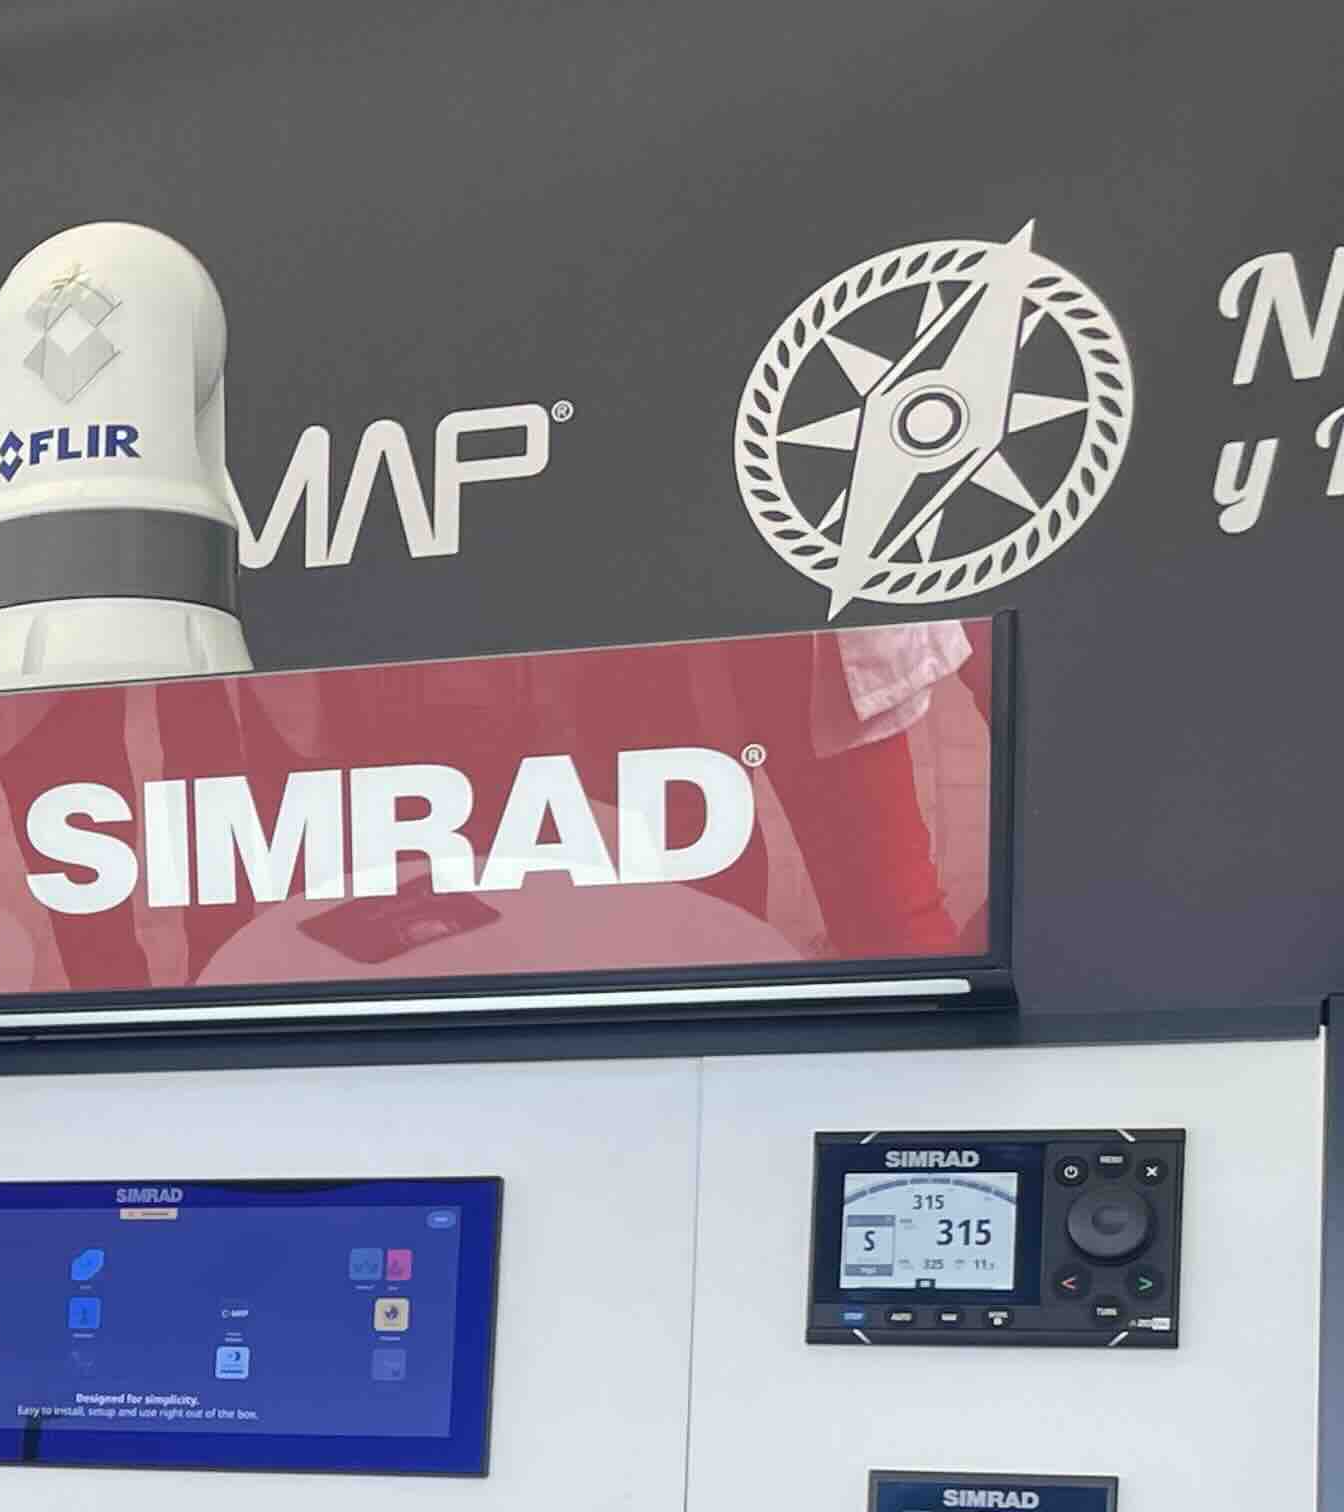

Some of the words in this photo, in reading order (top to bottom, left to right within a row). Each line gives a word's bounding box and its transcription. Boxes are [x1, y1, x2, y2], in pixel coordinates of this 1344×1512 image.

[28, 423, 140, 465] FLIR
[1213, 438, 1279, 533] y
[25, 745, 756, 915] SIMRAD
[884, 1150, 980, 1168] SIMRAD
[116, 1187, 184, 1203] SIMRAD
[912, 1194, 945, 1210] 315
[936, 1218, 992, 1246] 315
[943, 1489, 1040, 1509] SIMRAD
